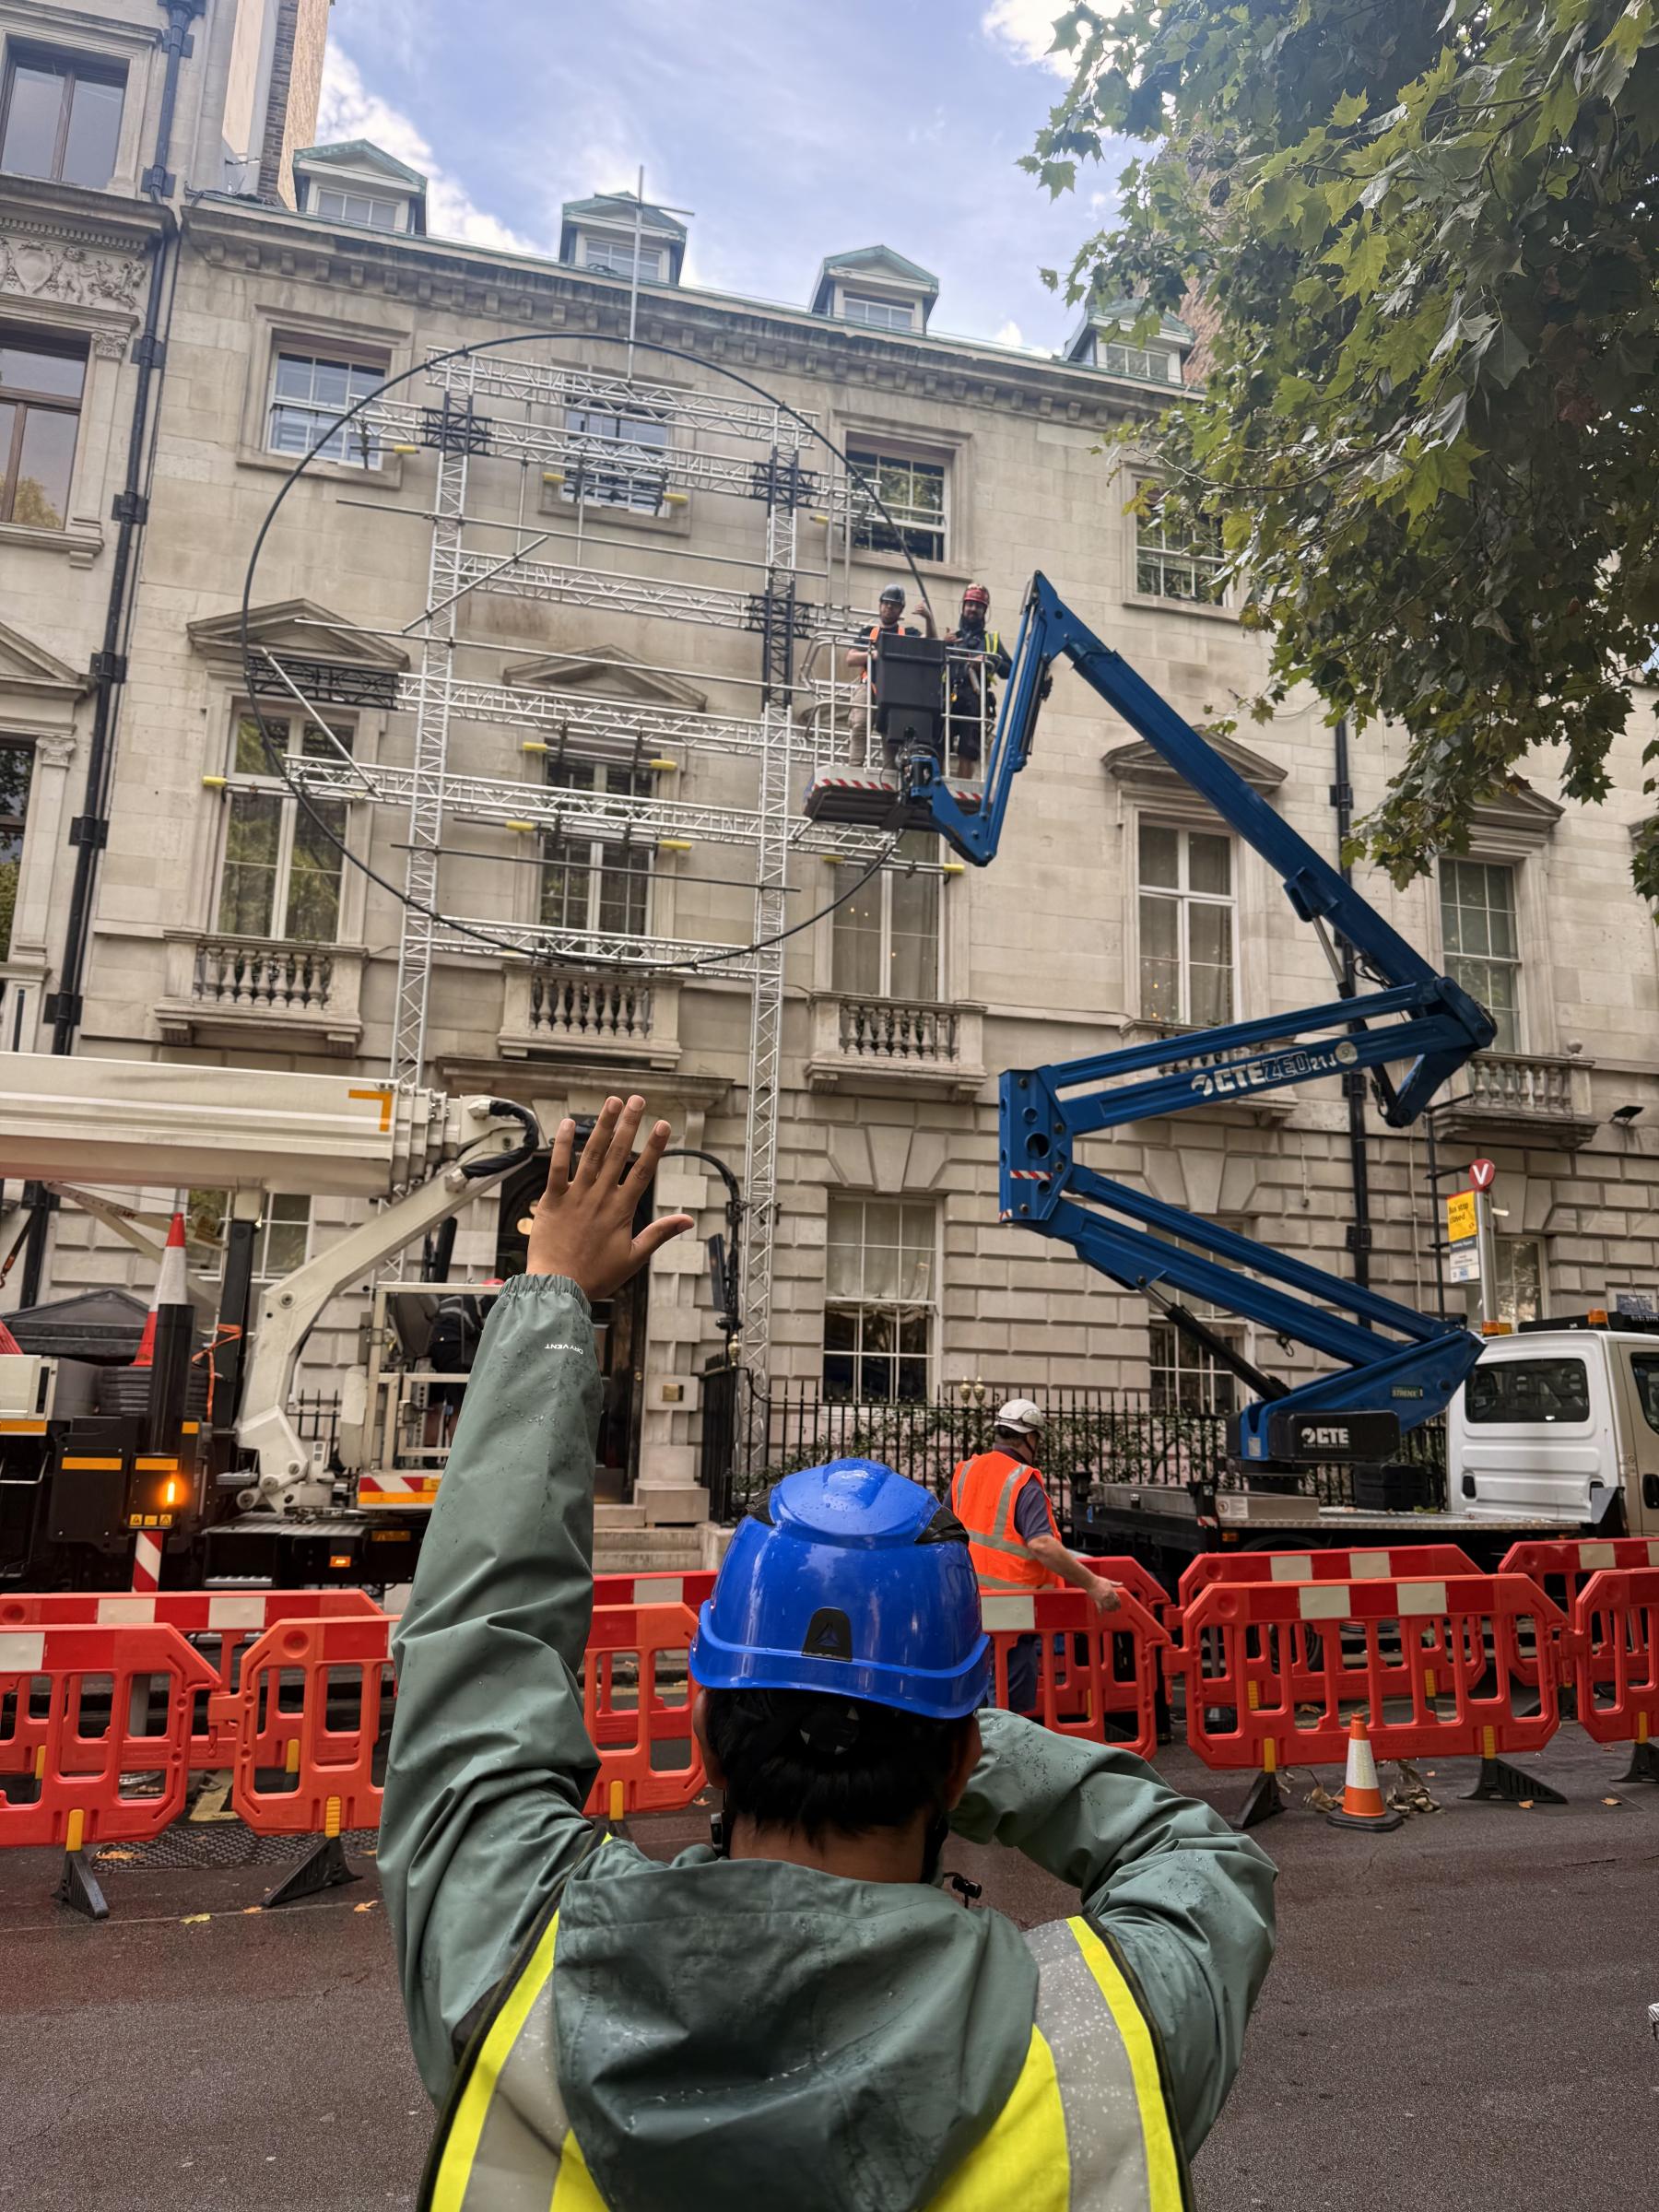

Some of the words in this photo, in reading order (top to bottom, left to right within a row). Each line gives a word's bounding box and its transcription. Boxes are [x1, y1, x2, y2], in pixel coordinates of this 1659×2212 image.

[1472, 1163, 1488, 1185] V
[1457, 1201, 1469, 1212] stop
[1316, 1428, 1349, 1444] CTE
